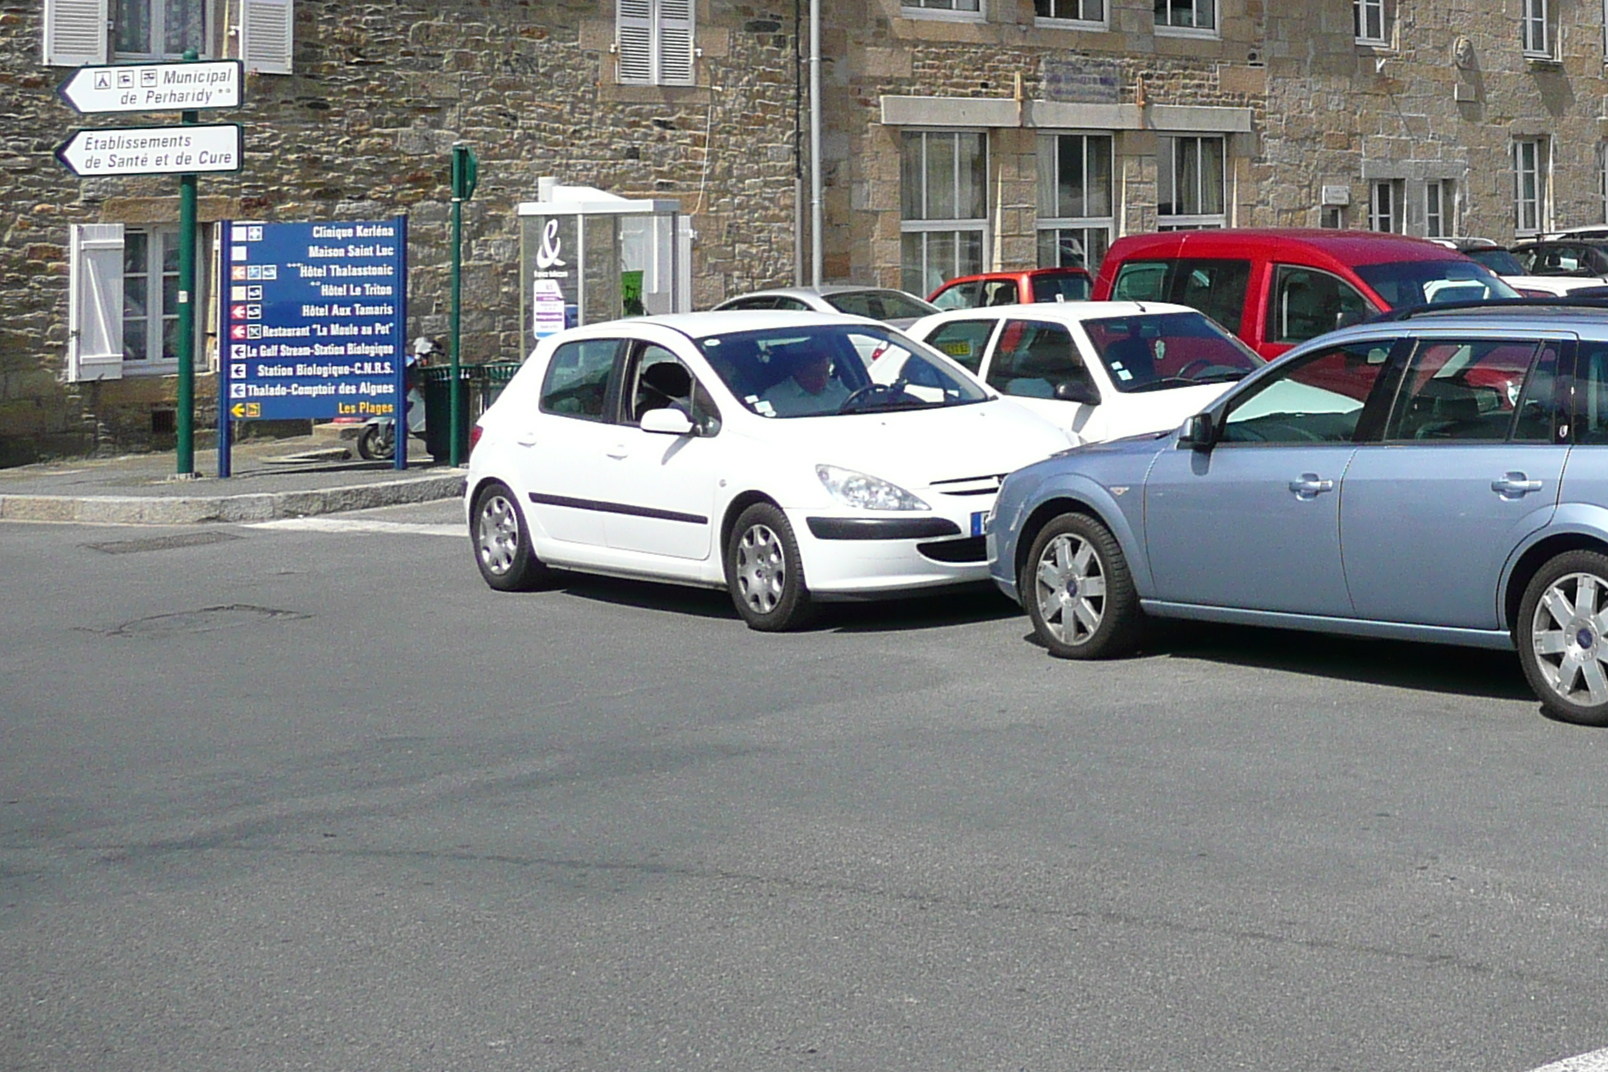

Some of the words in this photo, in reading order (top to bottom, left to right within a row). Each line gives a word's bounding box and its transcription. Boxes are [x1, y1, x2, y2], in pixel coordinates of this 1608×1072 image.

[163, 68, 232, 86] Municipal
[121, 92, 137, 105] de
[145, 89, 213, 105] Perharidy
[85, 133, 192, 151] Établissements
[85, 155, 101, 169] de
[108, 153, 148, 168] Santé
[155, 154, 168, 166] et
[176, 152, 192, 165] de
[198, 151, 232, 164] Cure
[312, 226, 353, 240] Clinique
[356, 225, 394, 237] Kerléna
[308, 245, 345, 257] Maison
[348, 245, 373, 257] Saint
[376, 244, 394, 256] Luc
[300, 265, 326, 277] Hôtel
[330, 264, 393, 277] Thalasstonic
[321, 284, 346, 296] Hôtel
[350, 284, 361, 296] Le
[364, 283, 392, 295] Triton
[302, 304, 328, 316] Hôtel
[331, 304, 350, 316] Aux
[354, 303, 393, 315] Tamaris
[262, 326, 310, 337] Restaurant
[331, 324, 358, 336] Moule
[361, 326, 372, 335] au
[247, 345, 257, 357] Le
[260, 345, 278, 357] Gulf
[347, 342, 394, 356] Biologique
[257, 364, 293, 376] Station
[339, 383, 356, 394] des
[359, 382, 394, 396] Algues
[339, 402, 356, 414] Les
[359, 401, 393, 415] Plages
